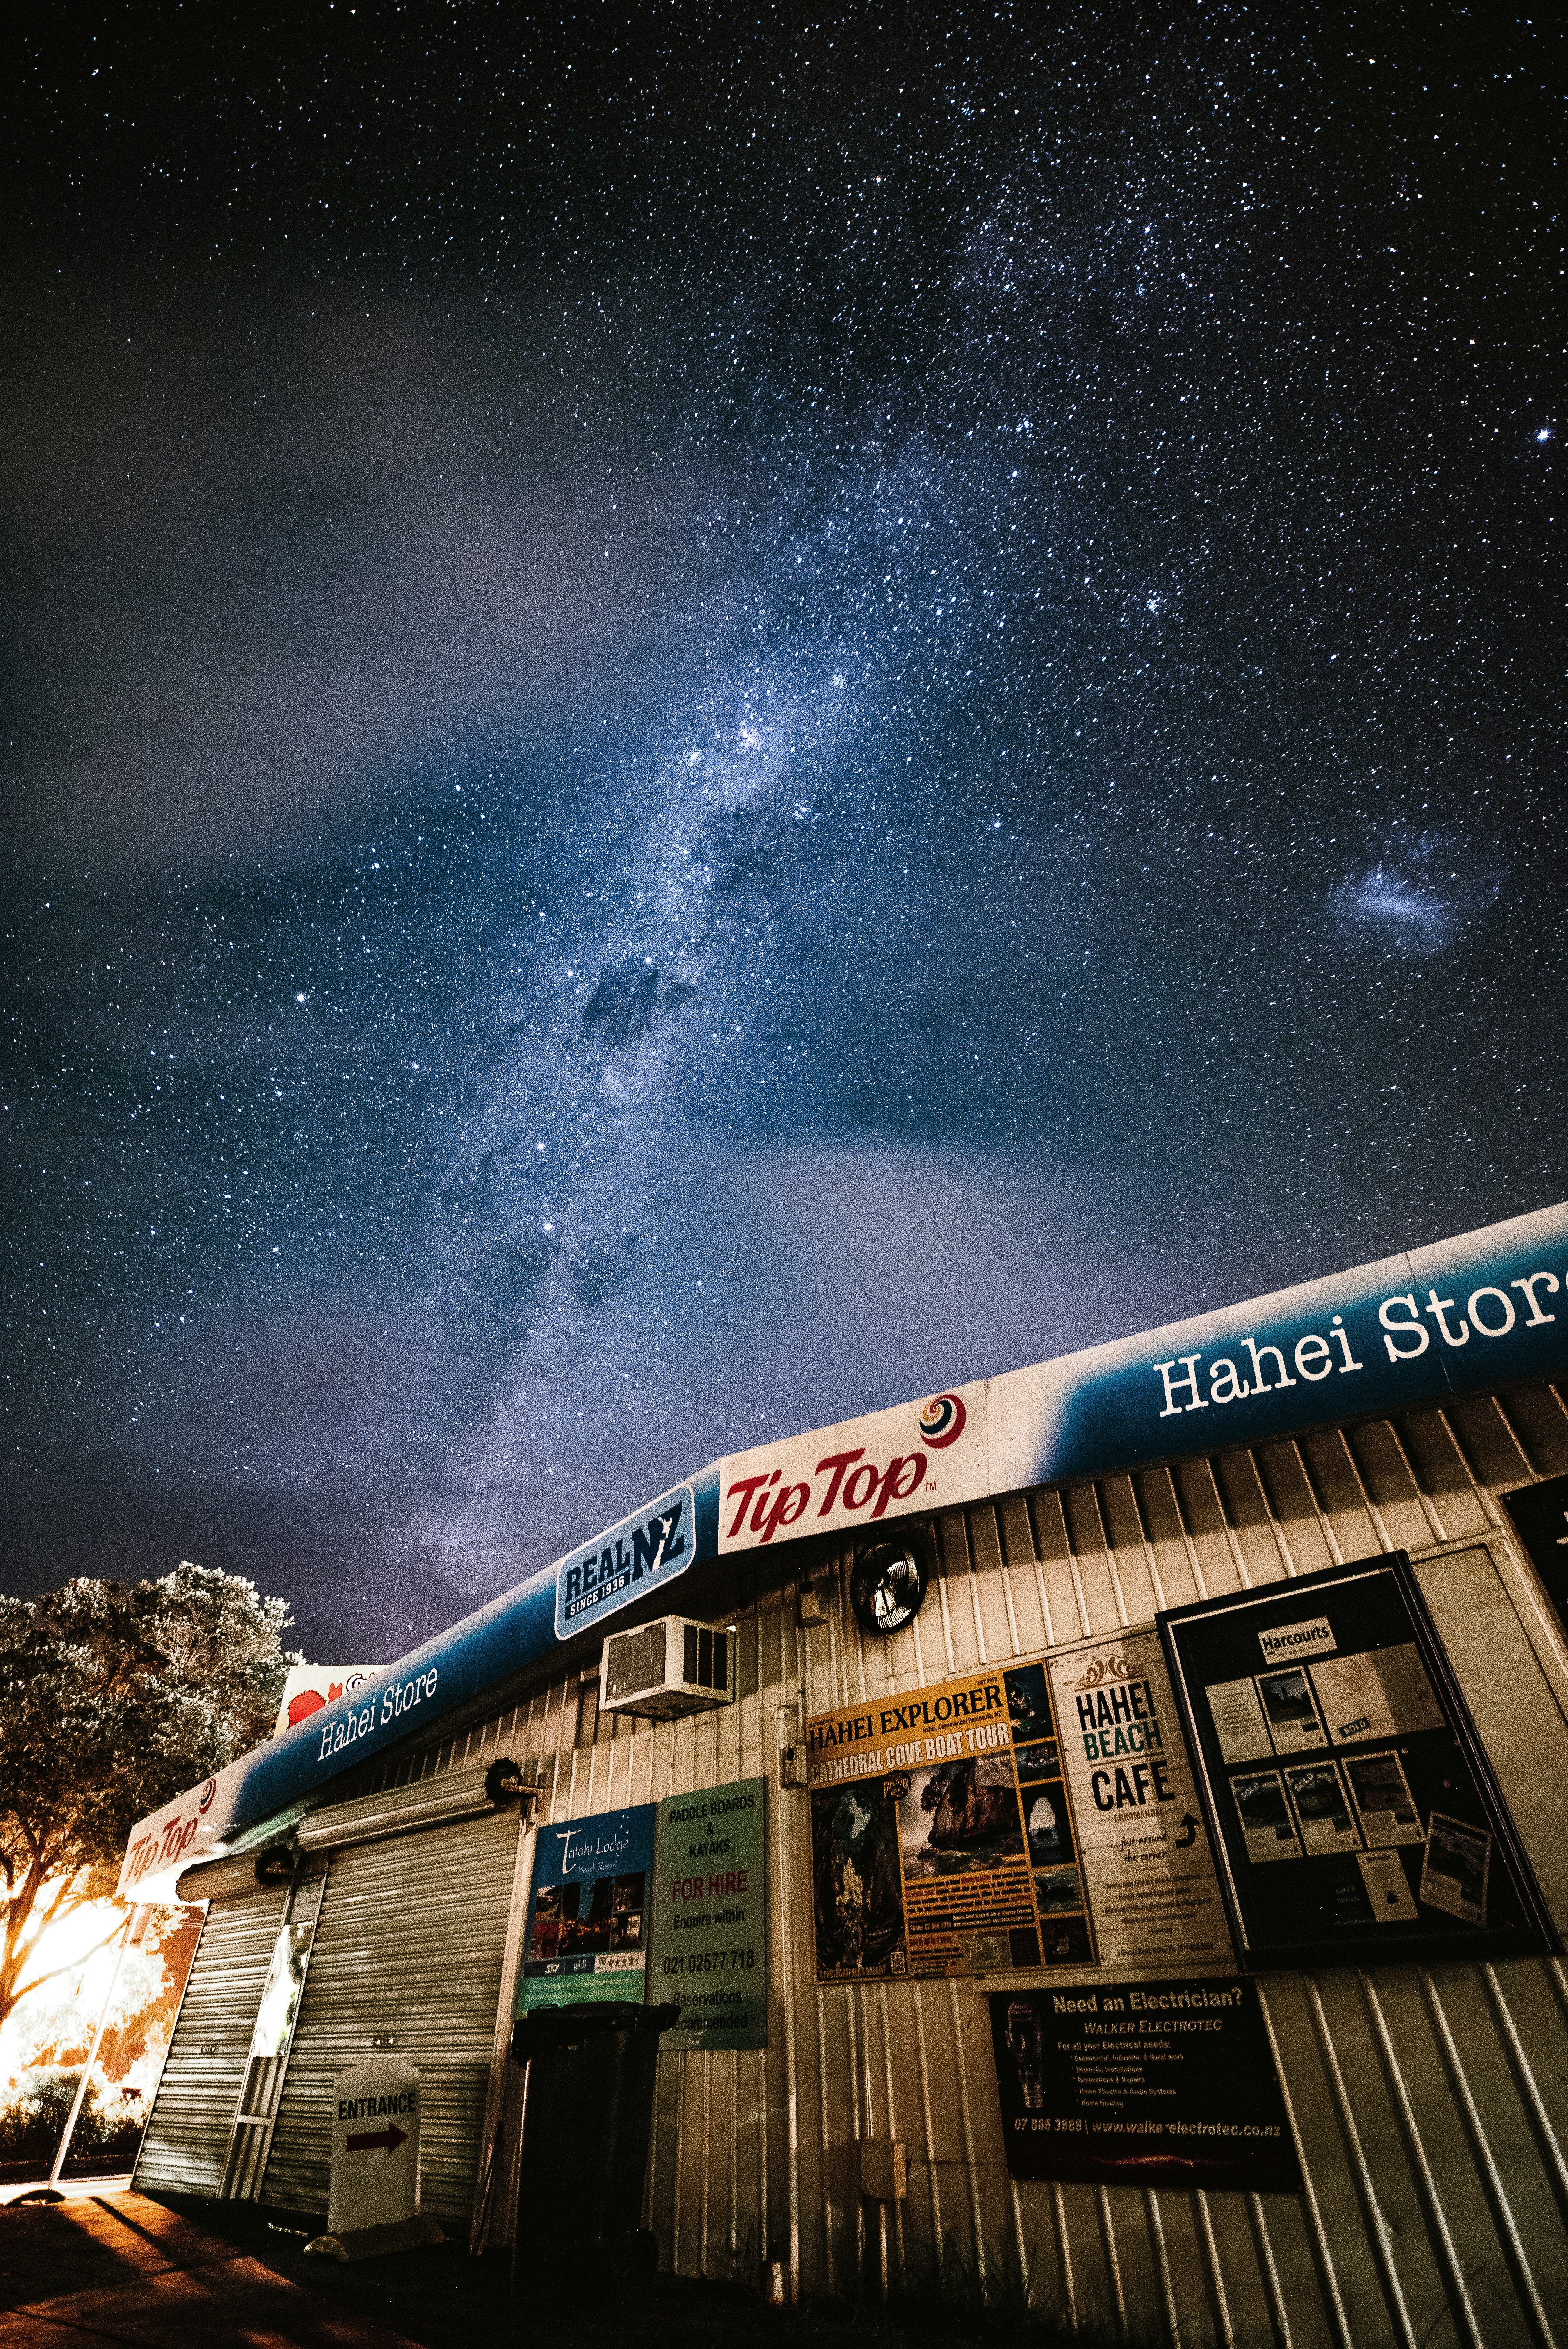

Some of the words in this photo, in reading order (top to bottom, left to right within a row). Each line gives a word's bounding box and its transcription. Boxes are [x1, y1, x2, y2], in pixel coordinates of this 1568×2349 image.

[1153, 1315, 1363, 1417] Hahei
[1379, 1269, 1568, 1363] Stor
[727, 1469, 810, 1543] Tip
[815, 1447, 927, 1518] Top
[570, 1592, 598, 1616] SINCE
[602, 1576, 624, 1597] 1936
[1262, 1626, 1329, 1651] Harcourts
[317, 1697, 376, 1762] Hahei
[381, 1668, 437, 1725] Store
[1076, 1680, 1156, 1731] HAHEI
[810, 1715, 873, 1750] HAHEI
[880, 1685, 1003, 1734] EXPLORER
[938, 1718, 968, 1729] Coromandel
[969, 1713, 994, 1723] Peninsula,
[1343, 1720, 1366, 1735] SOLD
[1082, 1720, 1163, 1761] BEACH
[811, 1749, 884, 1784] CATHEDRAL
[886, 1740, 923, 1768] COVE
[925, 1731, 963, 1760] BOAT
[966, 1722, 1009, 1752] TOUR
[1091, 1760, 1175, 1812] CAFE
[1240, 1782, 1259, 1800] SOLD
[1294, 1773, 1314, 1792] SOLD
[670, 1804, 708, 1823] PADDLE
[711, 1795, 754, 1815] BOARDS
[707, 1822, 714, 1835] &
[1139, 1827, 1167, 1843] around
[125, 1832, 159, 1883] Tip
[157, 1815, 198, 1864] Top
[595, 1833, 629, 1857] Lodge
[690, 1838, 730, 1858] KAYAKS
[1125, 1849, 1137, 1863] the
[1141, 1852, 1167, 1861] corner
[578, 1863, 596, 1874] Beach
[672, 1877, 704, 1901] FOR
[709, 1870, 747, 1896] HIRE
[674, 1912, 711, 1930] Enquire
[714, 1907, 745, 1924] within
[545, 1963, 561, 1974] SKY
[664, 1956, 683, 1975] 021
[689, 1951, 727, 1972] 02577
[731, 1949, 754, 1969] 718
[674, 1989, 742, 2007] Reservations
[1053, 1994, 1098, 2014] Need
[1103, 1996, 1124, 2011] an
[1129, 1986, 1243, 2010] Electrician?
[673, 2011, 747, 2030] ecommended
[1084, 2021, 1135, 2035] WALKER
[1139, 2019, 1222, 2034] ELECTROTEC
[1058, 2041, 1070, 2051] For
[1072, 2041, 1082, 2051] all
[1083, 2042, 1100, 2053] your
[1102, 2040, 1141, 2050] Electrical
[1143, 2039, 1171, 2049] needs:
[1149, 2053, 1166, 2061] Rural
[1168, 2052, 1185, 2060] work
[1121, 2075, 1146, 2084] Repairs
[1149, 2088, 1177, 2096] Systems
[338, 2093, 416, 2121] ENTRANCE
[1099, 2099, 1124, 2108] Heating
[1014, 2118, 1028, 2131] 07
[1031, 2118, 1051, 2132] 866
[1054, 2118, 1082, 2132] 3888
[1092, 2119, 1281, 2137] www.walkeelectrotec.co.nz
